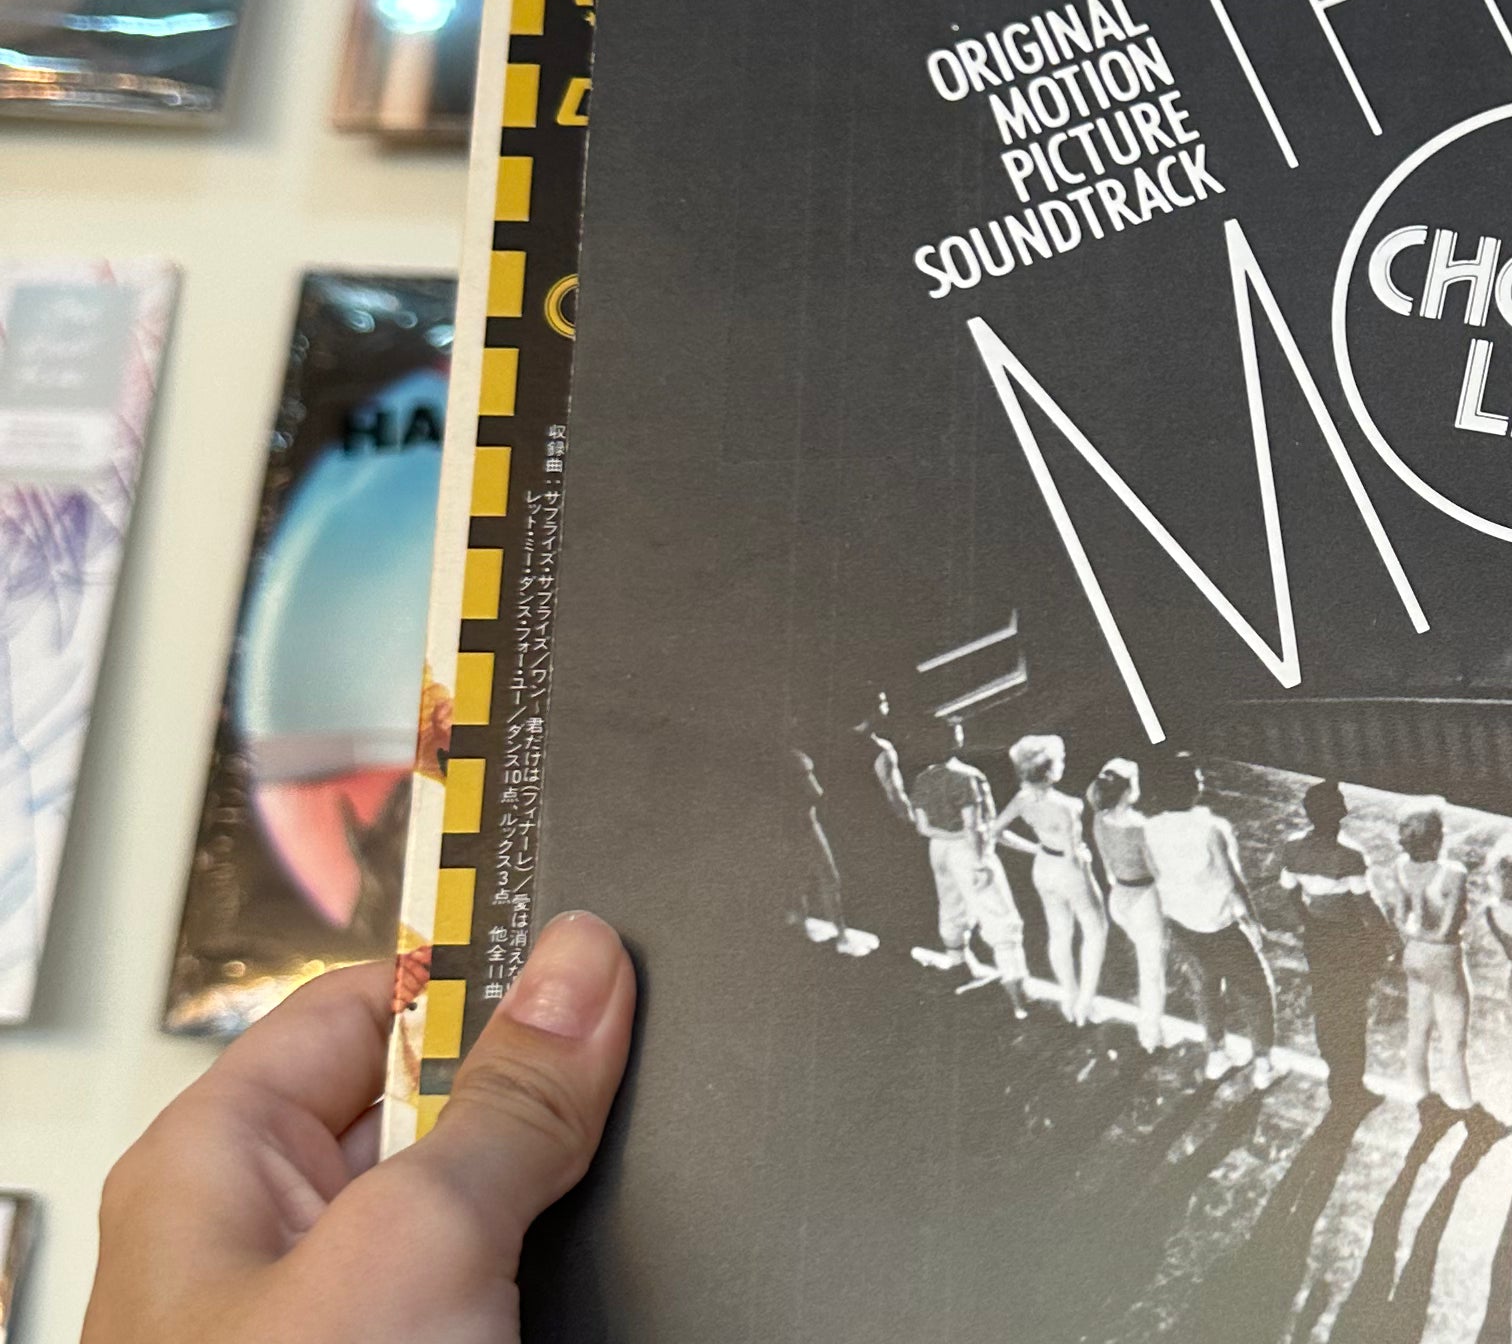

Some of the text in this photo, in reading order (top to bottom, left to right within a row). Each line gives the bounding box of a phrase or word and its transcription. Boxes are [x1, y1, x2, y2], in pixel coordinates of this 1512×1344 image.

[988, 36, 1176, 146] MOTION
[1001, 90, 1201, 205] PICTURE
[913, 144, 1227, 301] SOUNDTRACK
